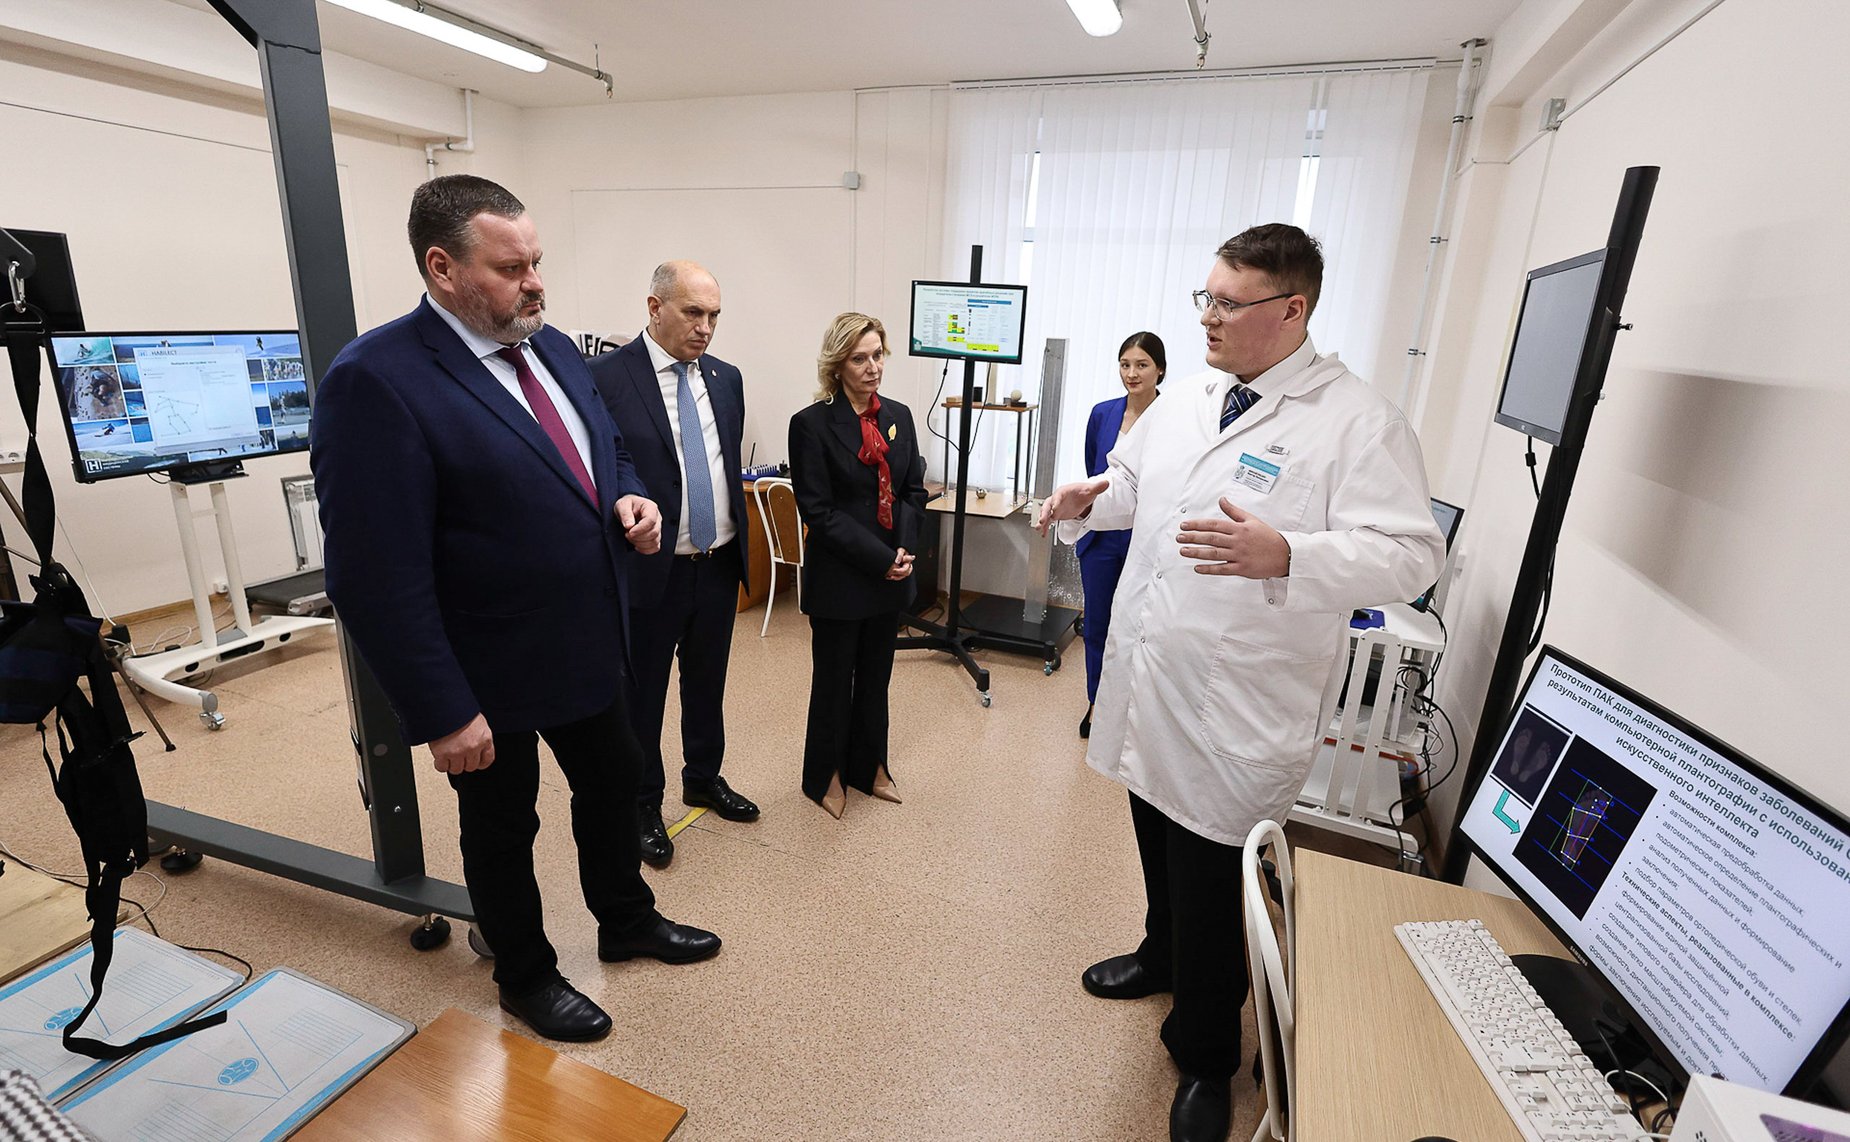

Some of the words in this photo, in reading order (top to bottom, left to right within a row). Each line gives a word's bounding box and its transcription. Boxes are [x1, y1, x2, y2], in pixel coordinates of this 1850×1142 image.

[1547, 679, 1604, 717] результатам
[1604, 712, 1678, 763] компьютерной
[1678, 759, 1758, 816] плантографии
[1759, 813, 1768, 823] с
[1550, 664, 1593, 693] Прототип
[1592, 688, 1616, 706] ПАК
[1612, 702, 1634, 718] для
[1633, 713, 1699, 757] диагностики
[1699, 753, 1759, 796] признаков
[1759, 792, 1845, 852] заболеваний
[1616, 736, 1694, 793] искусственного
[1695, 788, 1759, 838] интеллекта
[1669, 790, 1716, 828] Возможности
[1648, 844, 1671, 865] анализ
[1670, 862, 1708, 897] полученных
[1708, 894, 1734, 919] данных
[1734, 916, 1740, 924] и
[1740, 922, 1795, 973] формирование
[1655, 832, 1710, 879] подометрических
[1662, 821, 1714, 862] автоматическое
[1713, 860, 1759, 899] определение
[1759, 897, 1835, 963] плантографических
[1835, 961, 1843, 969] и
[1669, 809, 1721, 850] автоматическая
[1721, 847, 1774, 892] предобработка
[1601, 923, 1628, 951] создание
[1627, 949, 1644, 968] легко
[1643, 966, 1695, 1024] масштабируемой
[1608, 912, 1635, 940] создание
[1634, 938, 1661, 966] типового
[1660, 964, 1692, 1000] конвейера
[1691, 998, 1706, 1014] для
[1705, 1012, 1740, 1051] обработки
[1614, 901, 1669, 955] централизованной
[1668, 952, 1683, 971] базы
[1621, 871, 1660, 910] Технические
[1660, 908, 1688, 937] аспекты,
[1688, 934, 1744, 990] реализованные
[1744, 989, 1751, 997] в
[1621, 890, 1665, 932] формирование
[1665, 931, 1688, 954] единой
[1687, 953, 1730, 997] защищённой
[1635, 867, 1657, 889] подбор
[1657, 886, 1694, 922] параметров
[1693, 920, 1747, 971] ортопедической
[1746, 969, 1768, 992] обуви
[1589, 945, 1609, 967] формы
[1608, 965, 1642, 1003] заключения
[1641, 1002, 1681, 1050] исследуемым
[1680, 1048, 1686, 1056] и
[1595, 934, 1630, 973] возможность
[1630, 971, 1676, 1023] дистанционного
[1676, 1021, 1710, 1061] получения
